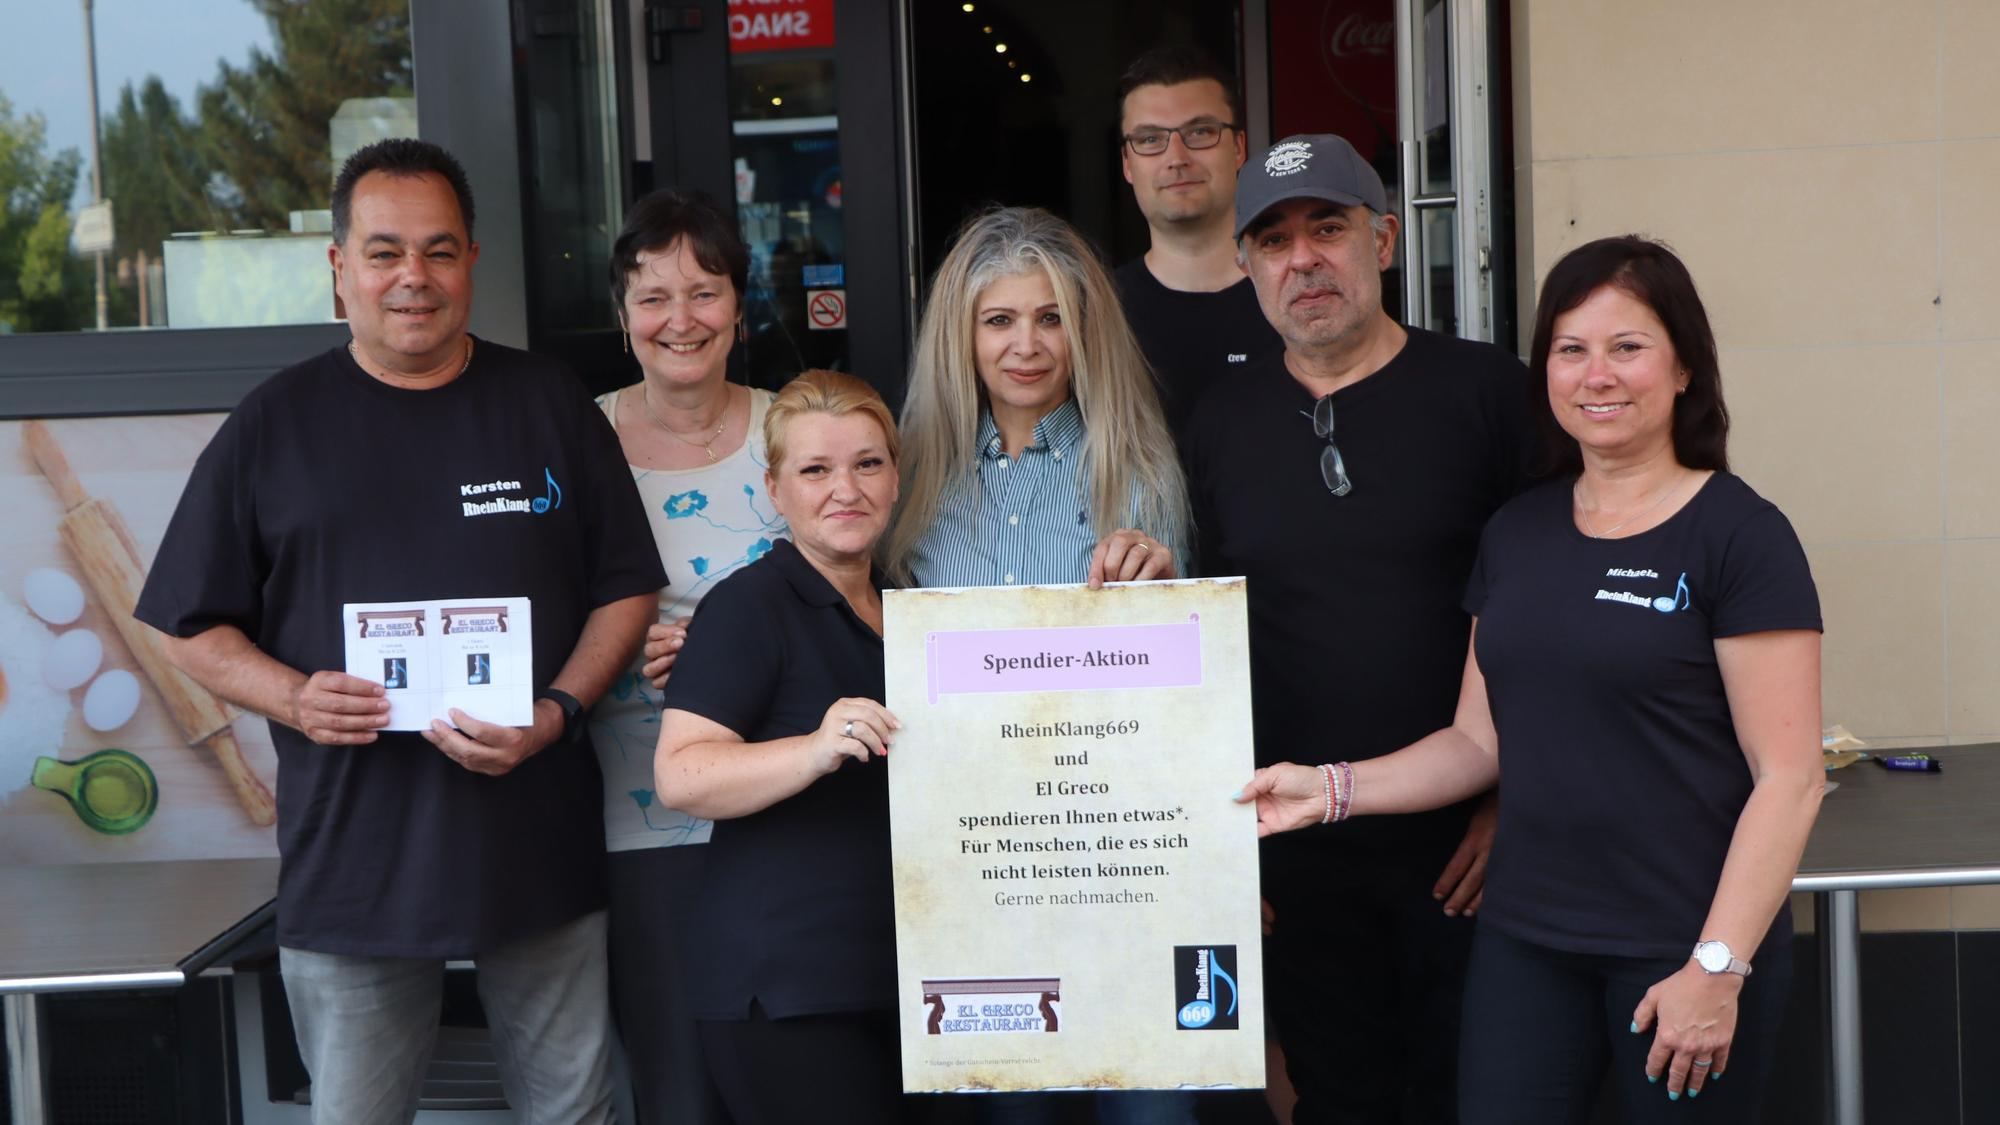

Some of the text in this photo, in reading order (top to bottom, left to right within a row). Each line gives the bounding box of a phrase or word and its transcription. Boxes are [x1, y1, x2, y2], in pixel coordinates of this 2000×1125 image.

[1227, 353, 1247, 363] Crew
[460, 480, 522, 496] Karsten
[462, 497, 531, 517] RheinKlang
[1605, 568, 1659, 580] Michaela
[1594, 589, 1652, 608] RheinKlang
[367, 629, 417, 638] RESTAURANT
[450, 625, 500, 634] RESTAURANT
[983, 649, 1150, 675] Spendier-Aktion
[1000, 719, 1140, 740] RheinKlang669
[1054, 751, 1089, 766] und
[1036, 780, 1110, 796] El Greco
[958, 811, 1061, 831] spendieren
[1066, 808, 1118, 825] Ihnen
[961, 833, 1189, 854] Für Menschen, die es sich
[981, 861, 1171, 880] nicht leisten können.
[994, 888, 1160, 906] Gerne nachmachen.
[1195, 949, 1209, 1000] RheinKlang
[958, 1003, 1035, 1018] EL GRECO
[1182, 1005, 1211, 1023] 669
[943, 1018, 1043, 1033] RESTAURANT
